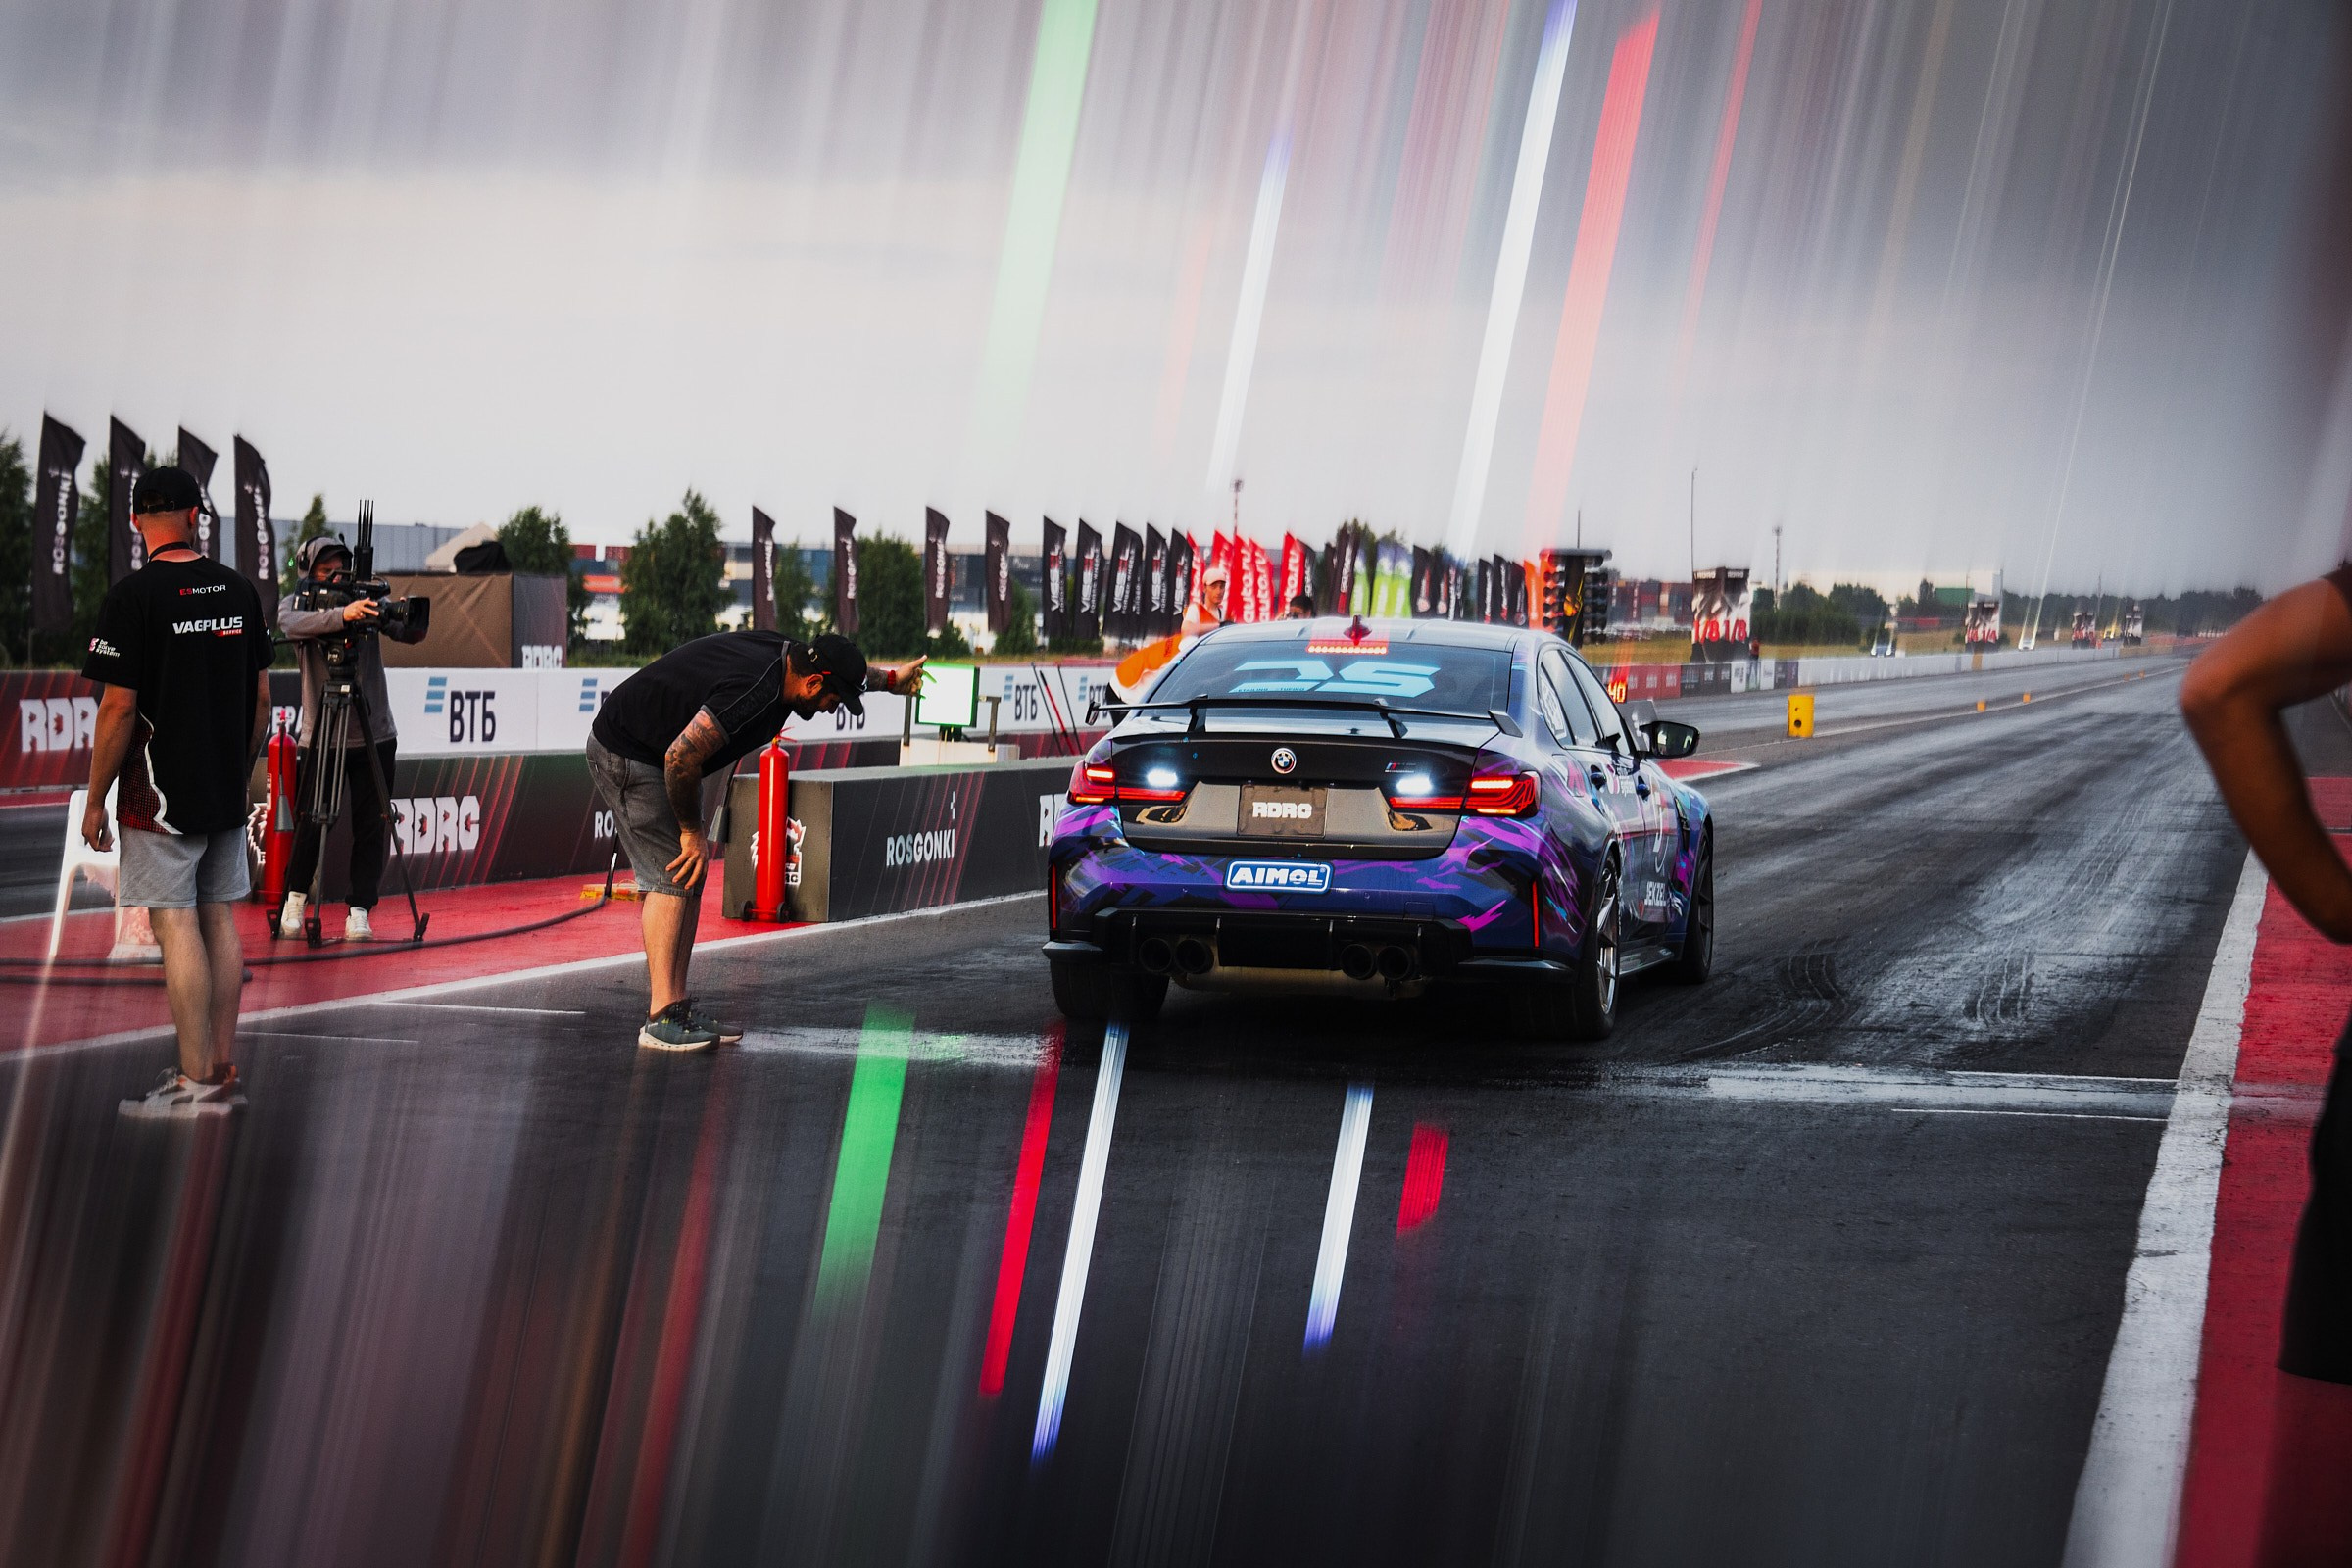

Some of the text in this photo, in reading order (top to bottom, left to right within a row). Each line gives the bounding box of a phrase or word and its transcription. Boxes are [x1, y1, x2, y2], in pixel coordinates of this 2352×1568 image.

[1081, 545, 1095, 613] VISSEL
[1112, 545, 1130, 612] VISSEL
[1240, 549, 1255, 623] auto.ru
[172, 616, 243, 635] VAGPLUS
[1724, 618, 1747, 644] 1/8
[449, 690, 497, 743] ВТБ
[1014, 684, 1038, 721] ВТБ
[20, 696, 97, 754] RDR
[1252, 801, 1313, 819] RDRC
[886, 829, 956, 867] ROSGONKI
[1231, 867, 1324, 886] AIMOL
